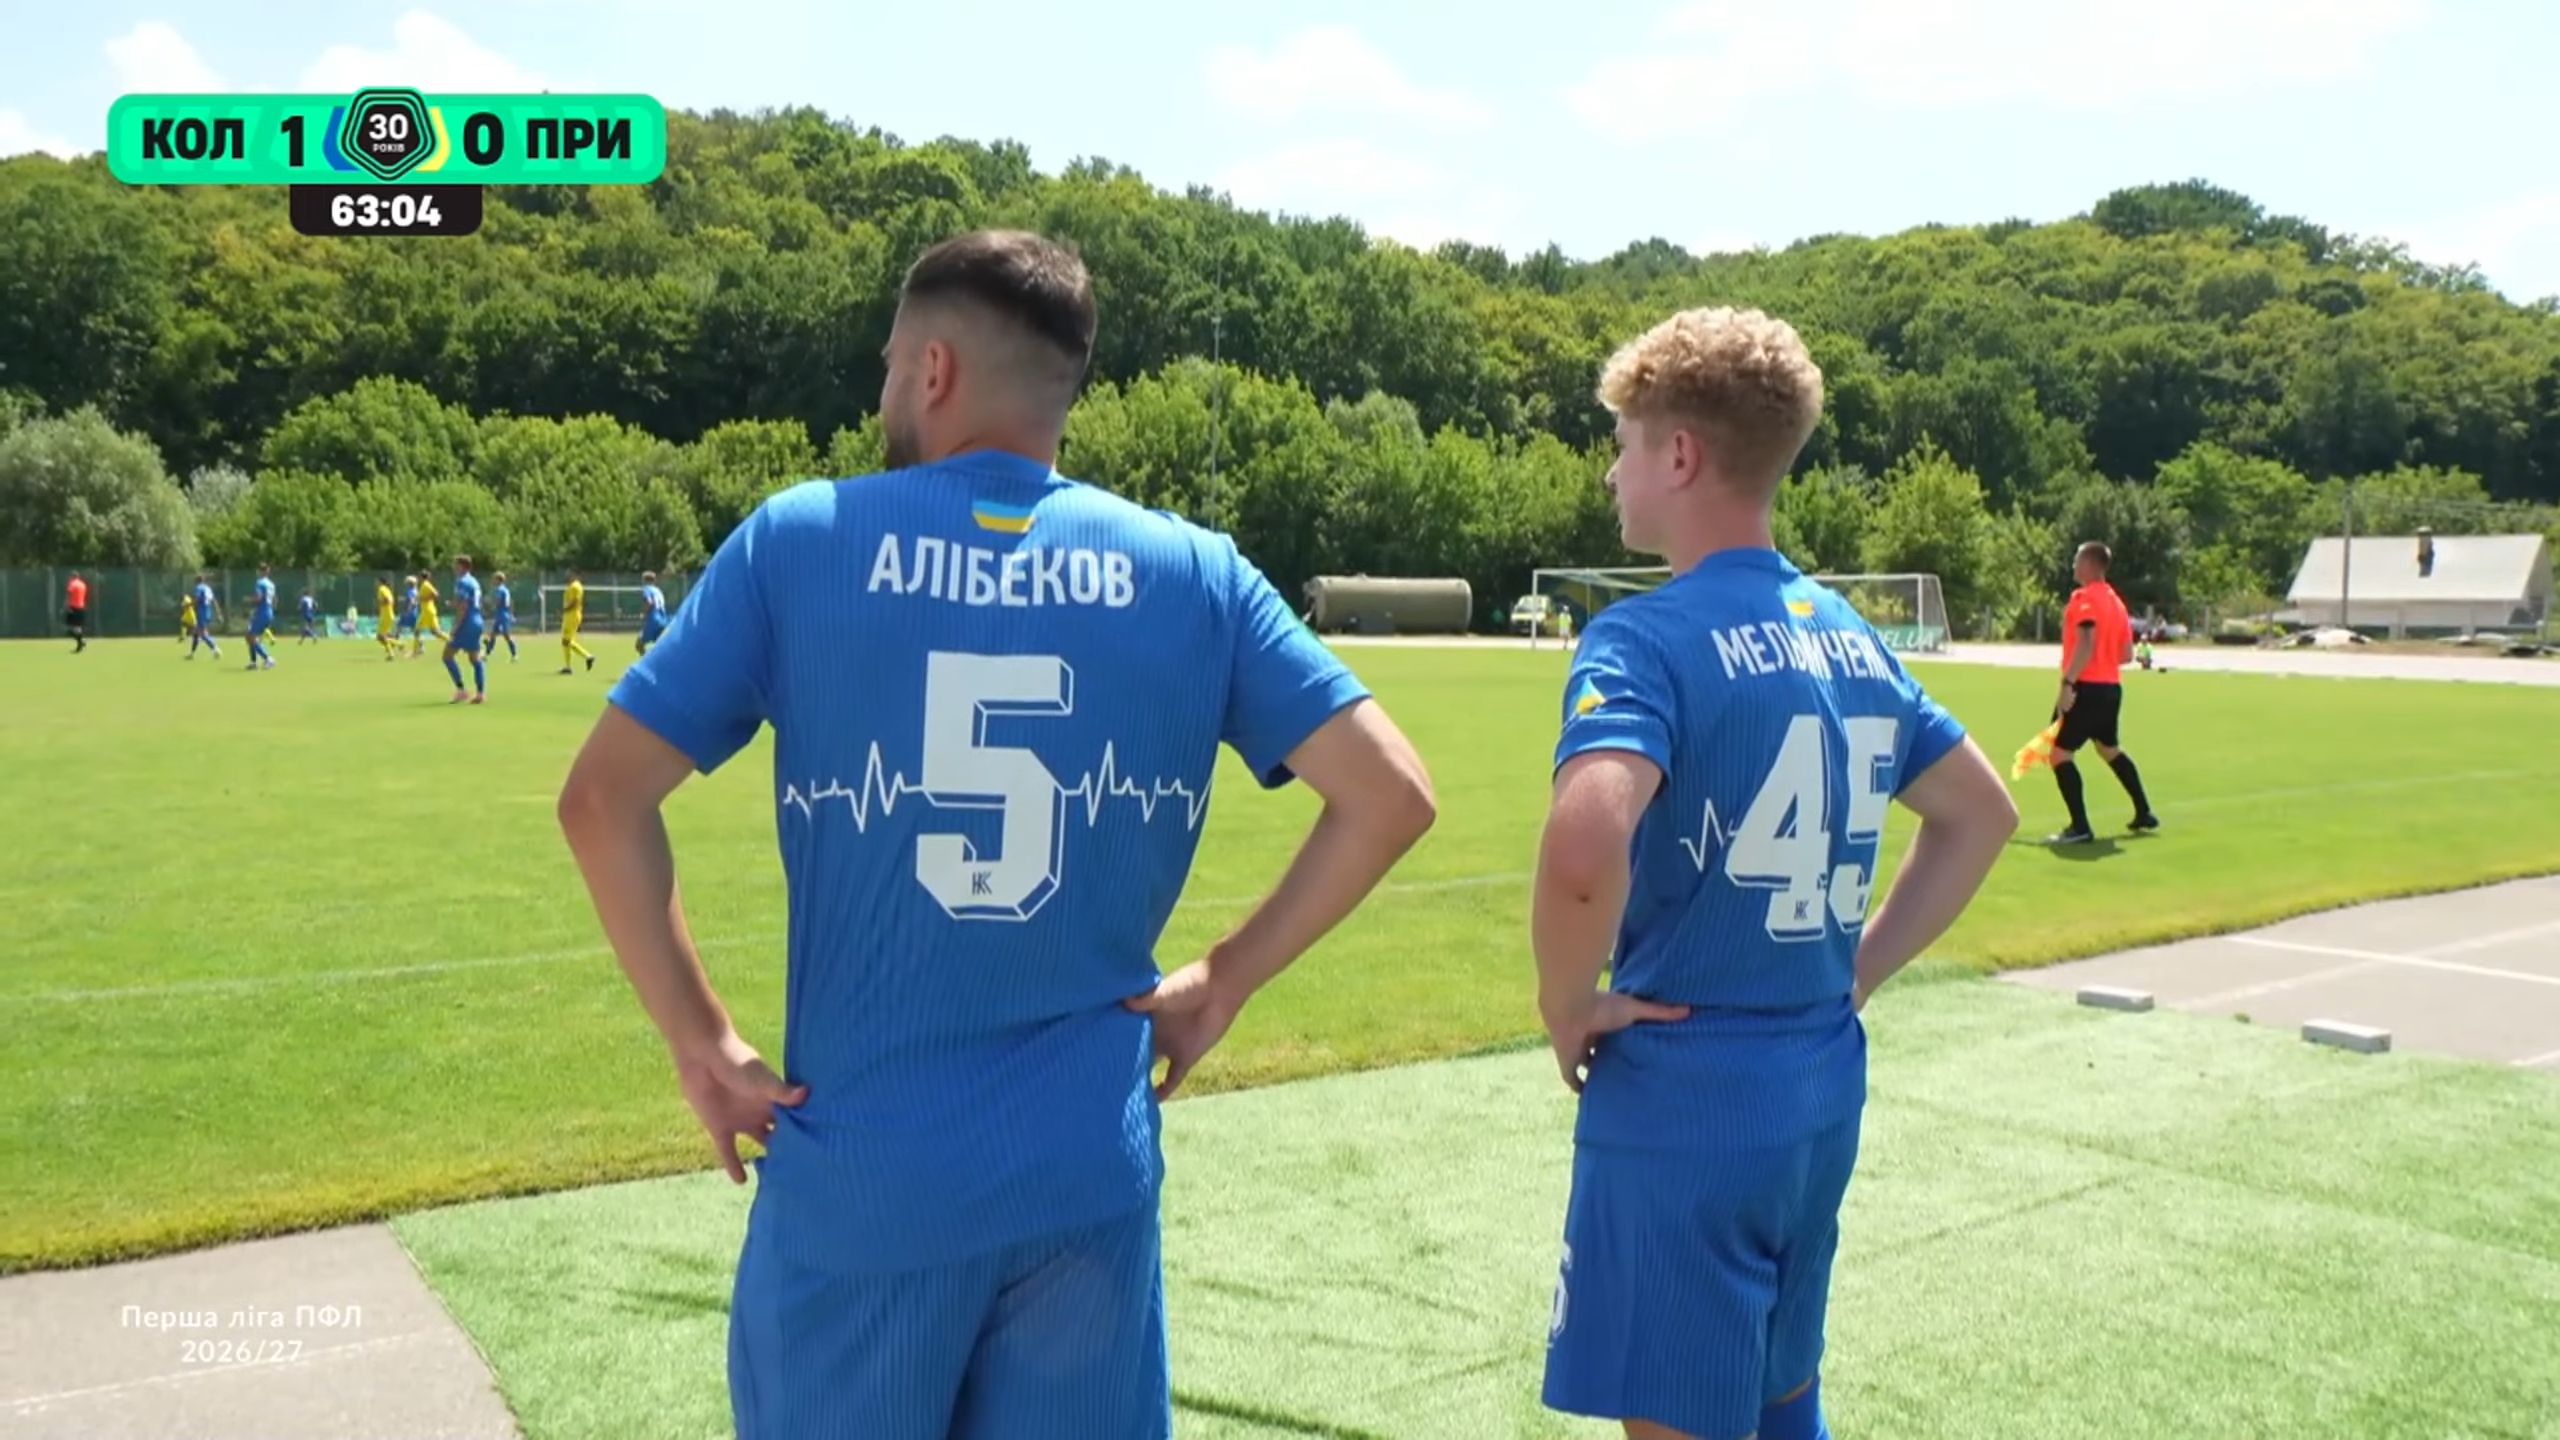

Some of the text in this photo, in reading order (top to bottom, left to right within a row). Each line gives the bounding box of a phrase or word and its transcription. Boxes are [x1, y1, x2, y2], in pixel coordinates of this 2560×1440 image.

[867, 533, 1135, 608] АЛІБЕКОВ
[916, 651, 1074, 921] 5
[1725, 714, 1898, 942] 45
